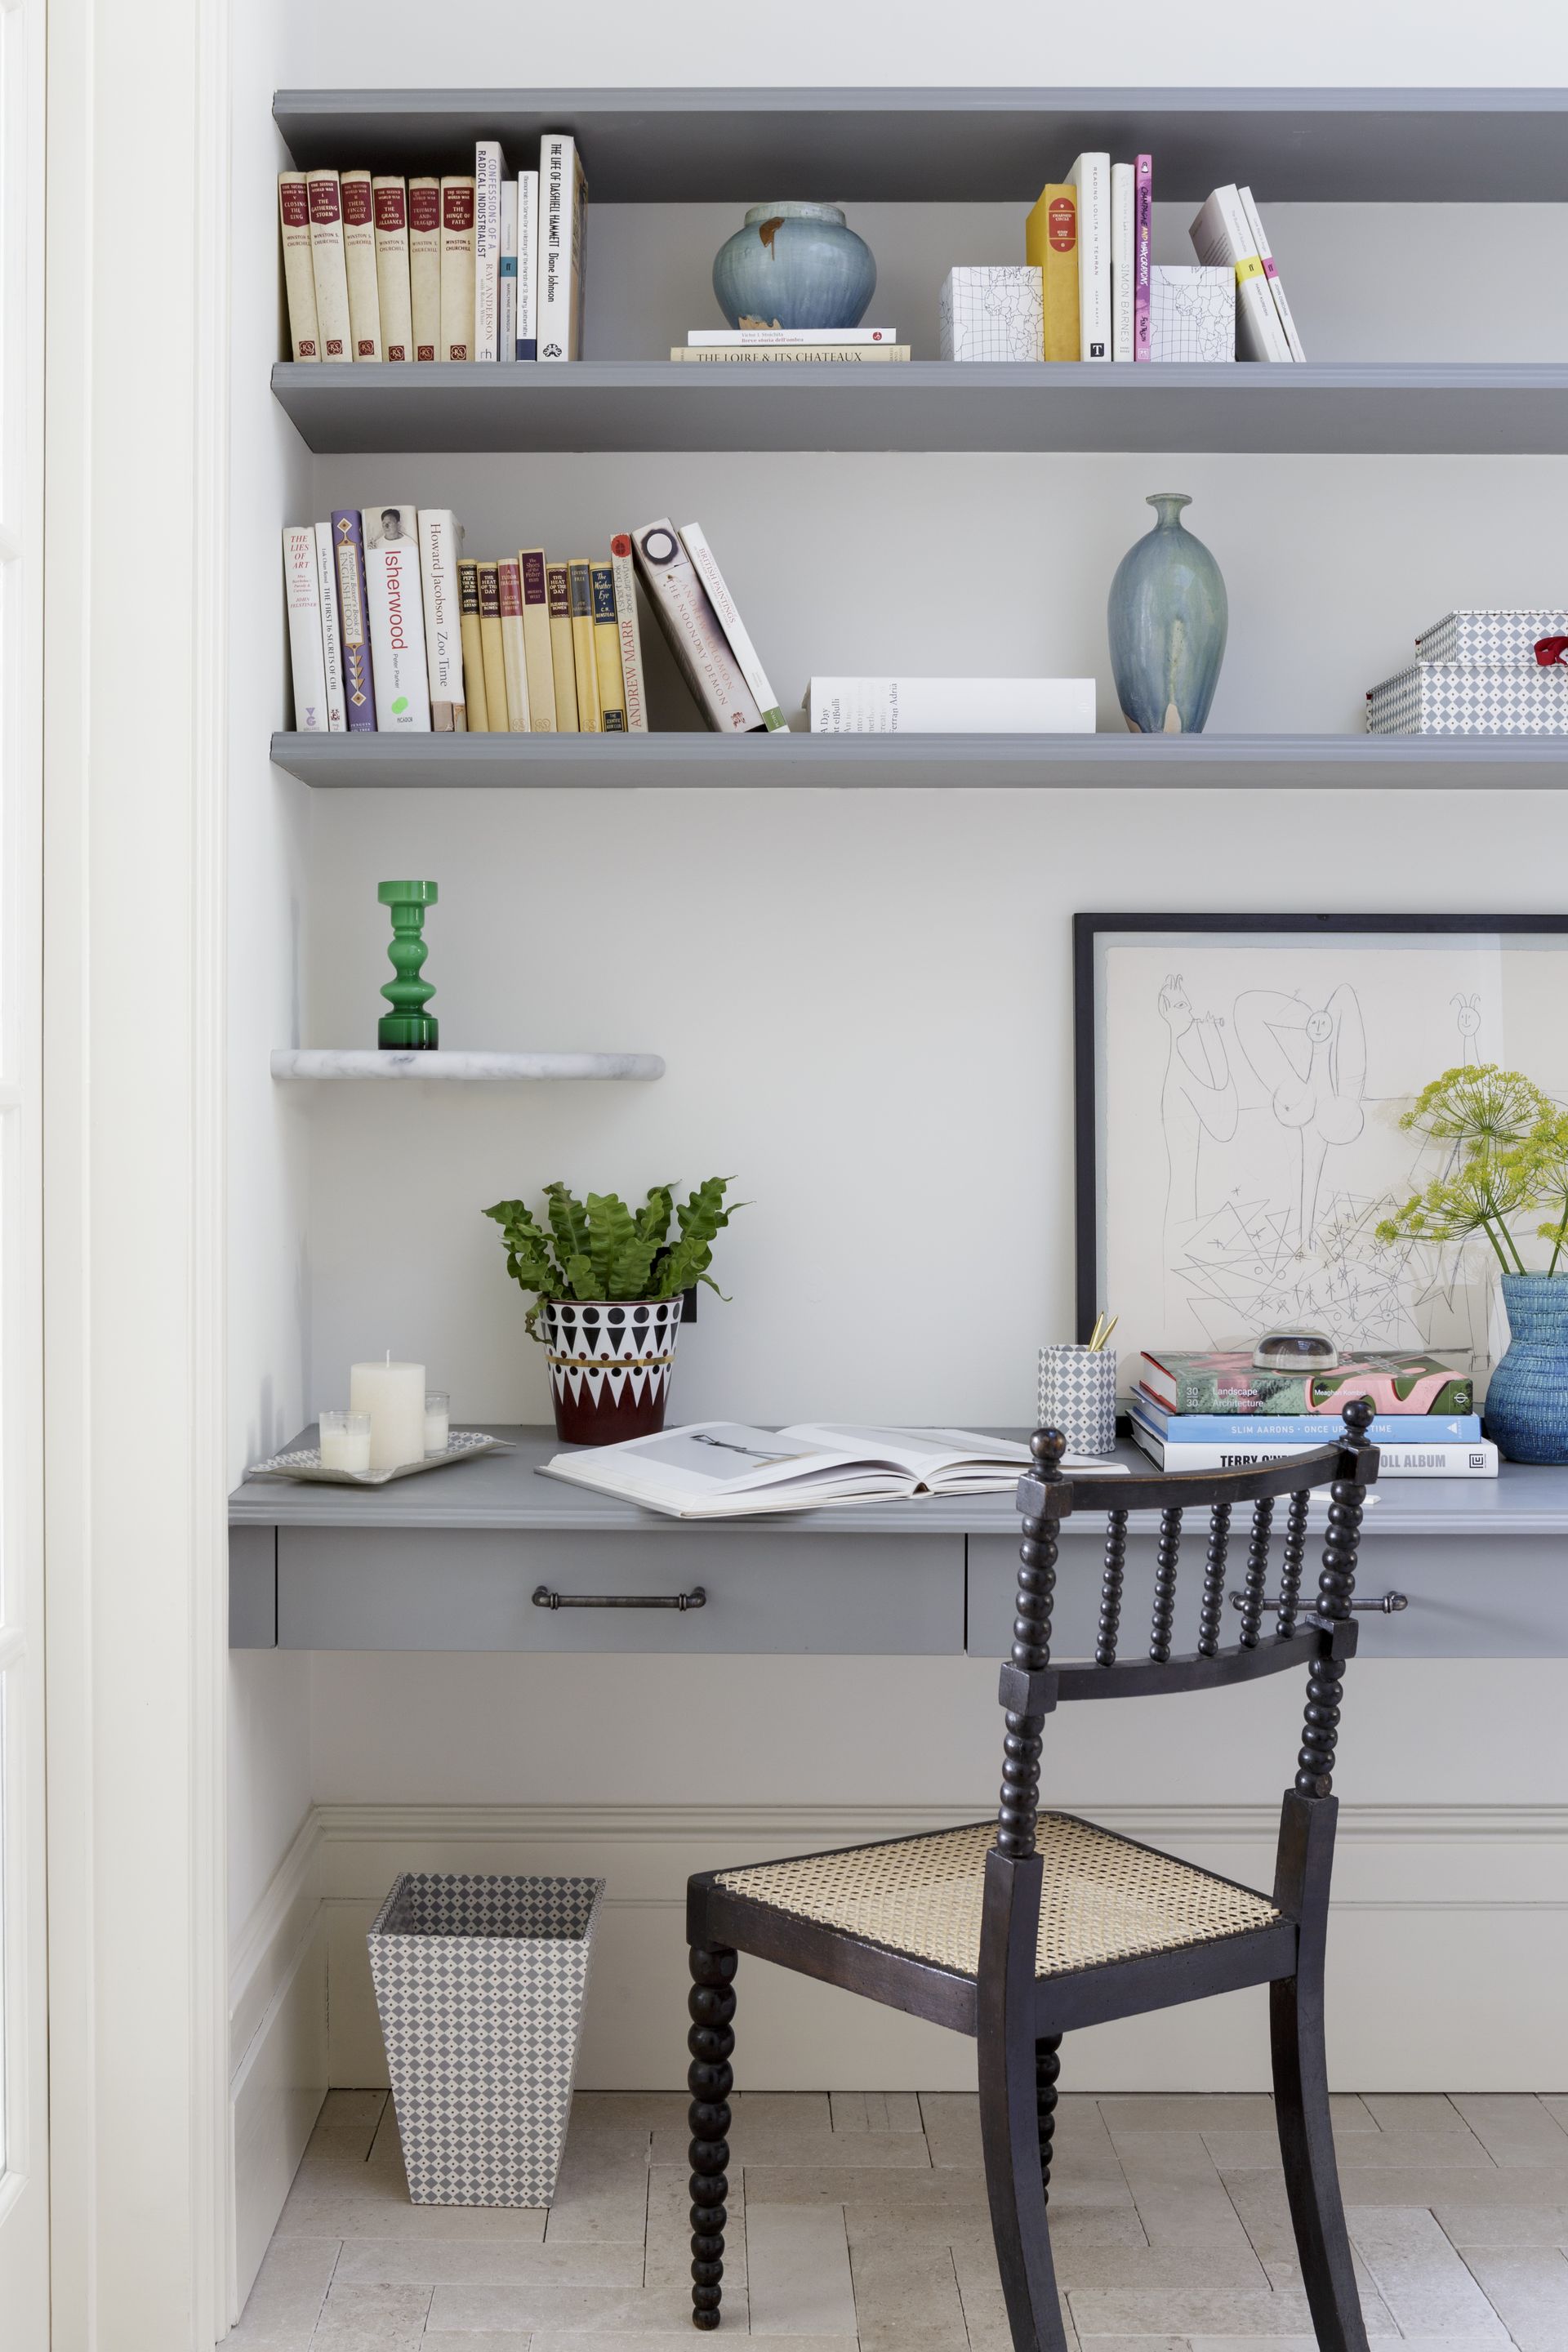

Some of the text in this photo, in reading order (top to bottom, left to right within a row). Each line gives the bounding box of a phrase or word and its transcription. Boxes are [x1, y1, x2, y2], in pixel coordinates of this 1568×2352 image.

[478, 151, 486, 258] RADICAL INDUSTRIALIST
[488, 159, 497, 223] CONFESSIONS
[488, 228, 496, 240] OF
[548, 144, 561, 302] THE LIFE OF DASHIELL HAMMETT Diane Johnson
[1140, 241, 1148, 256] WAX
[1121, 264, 1129, 297] SIMON
[1121, 302, 1129, 342] BARNES
[762, 353, 769, 361] &
[775, 353, 792, 361] ITS
[796, 352, 862, 361] CHATEAUX
[614, 565, 622, 583] book
[622, 559, 631, 591] drawing
[699, 548, 717, 580] BRITISH
[714, 581, 735, 623] PAINTINGS
[340, 552, 353, 635] ENGLISH FOOD
[385, 551, 408, 649] Isherwood
[431, 524, 450, 686] Howard Jacobson Zoo Time
[599, 590, 609, 601] Eye
[616, 584, 625, 606] short
[667, 578, 728, 705] THE NOONDAY DEMON
[682, 583, 707, 629] ANDREW
[705, 636, 734, 690] SOLOMON
[329, 666, 335, 675] OF
[622, 620, 641, 727] ANDREW MARR
[820, 709, 830, 725] Day
[832, 698, 840, 724] elBulli
[1186, 1387, 1198, 1396] 30
[1213, 1388, 1258, 1397] Landscape
[1314, 1389, 1341, 1398] Meaghan
[1221, 1455, 1258, 1467] TERRY
[1380, 1455, 1400, 1467] OLL
[1404, 1455, 1446, 1468] ALBUM
